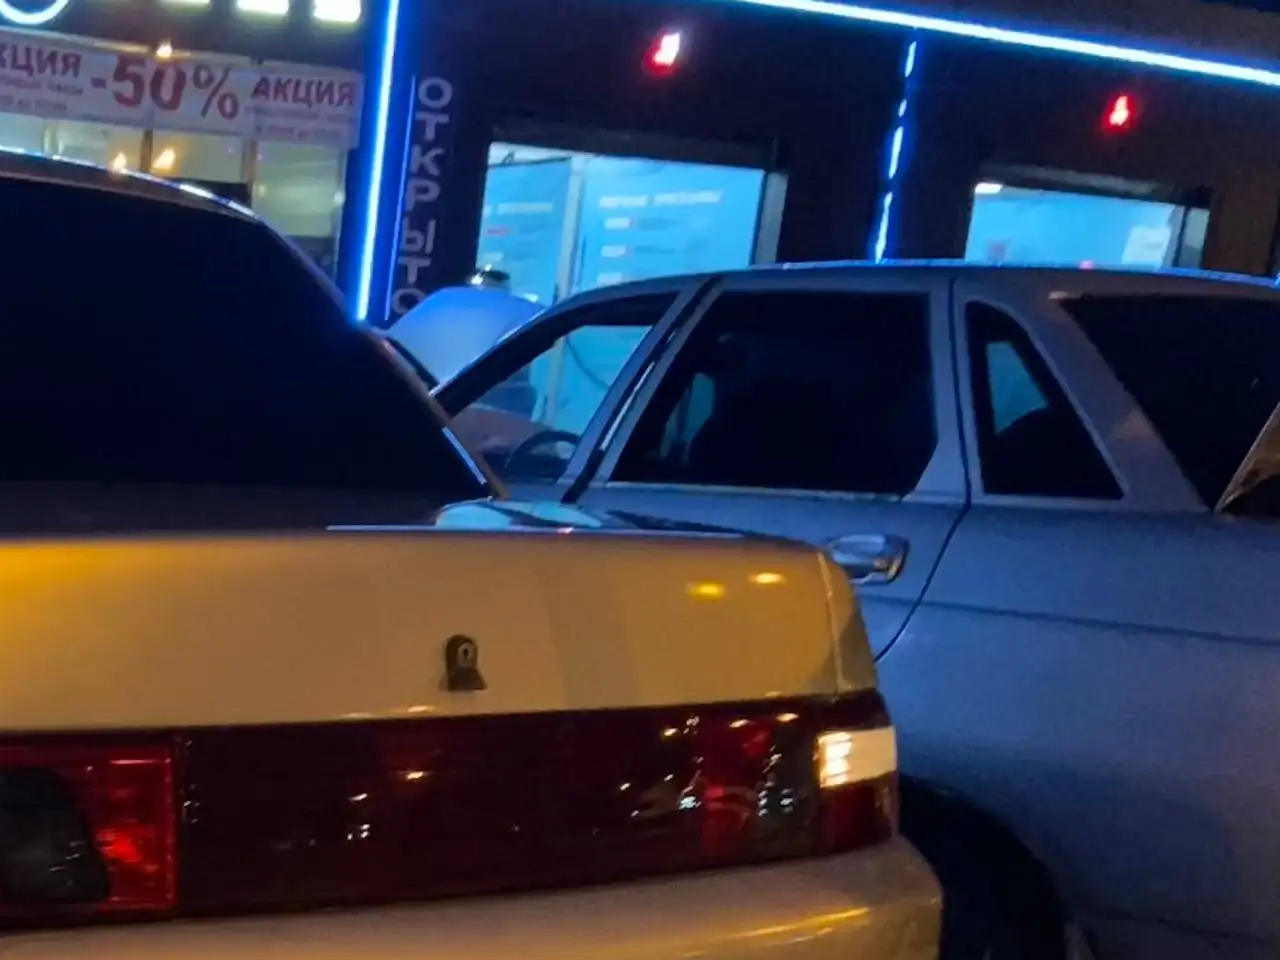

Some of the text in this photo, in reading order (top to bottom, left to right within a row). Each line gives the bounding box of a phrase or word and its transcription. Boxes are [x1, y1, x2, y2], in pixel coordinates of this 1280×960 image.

[91, 54, 239, 120] -50%
[251, 76, 356, 108] АКЦИЯ
[392, 77, 454, 315] ОТКРЫТО
